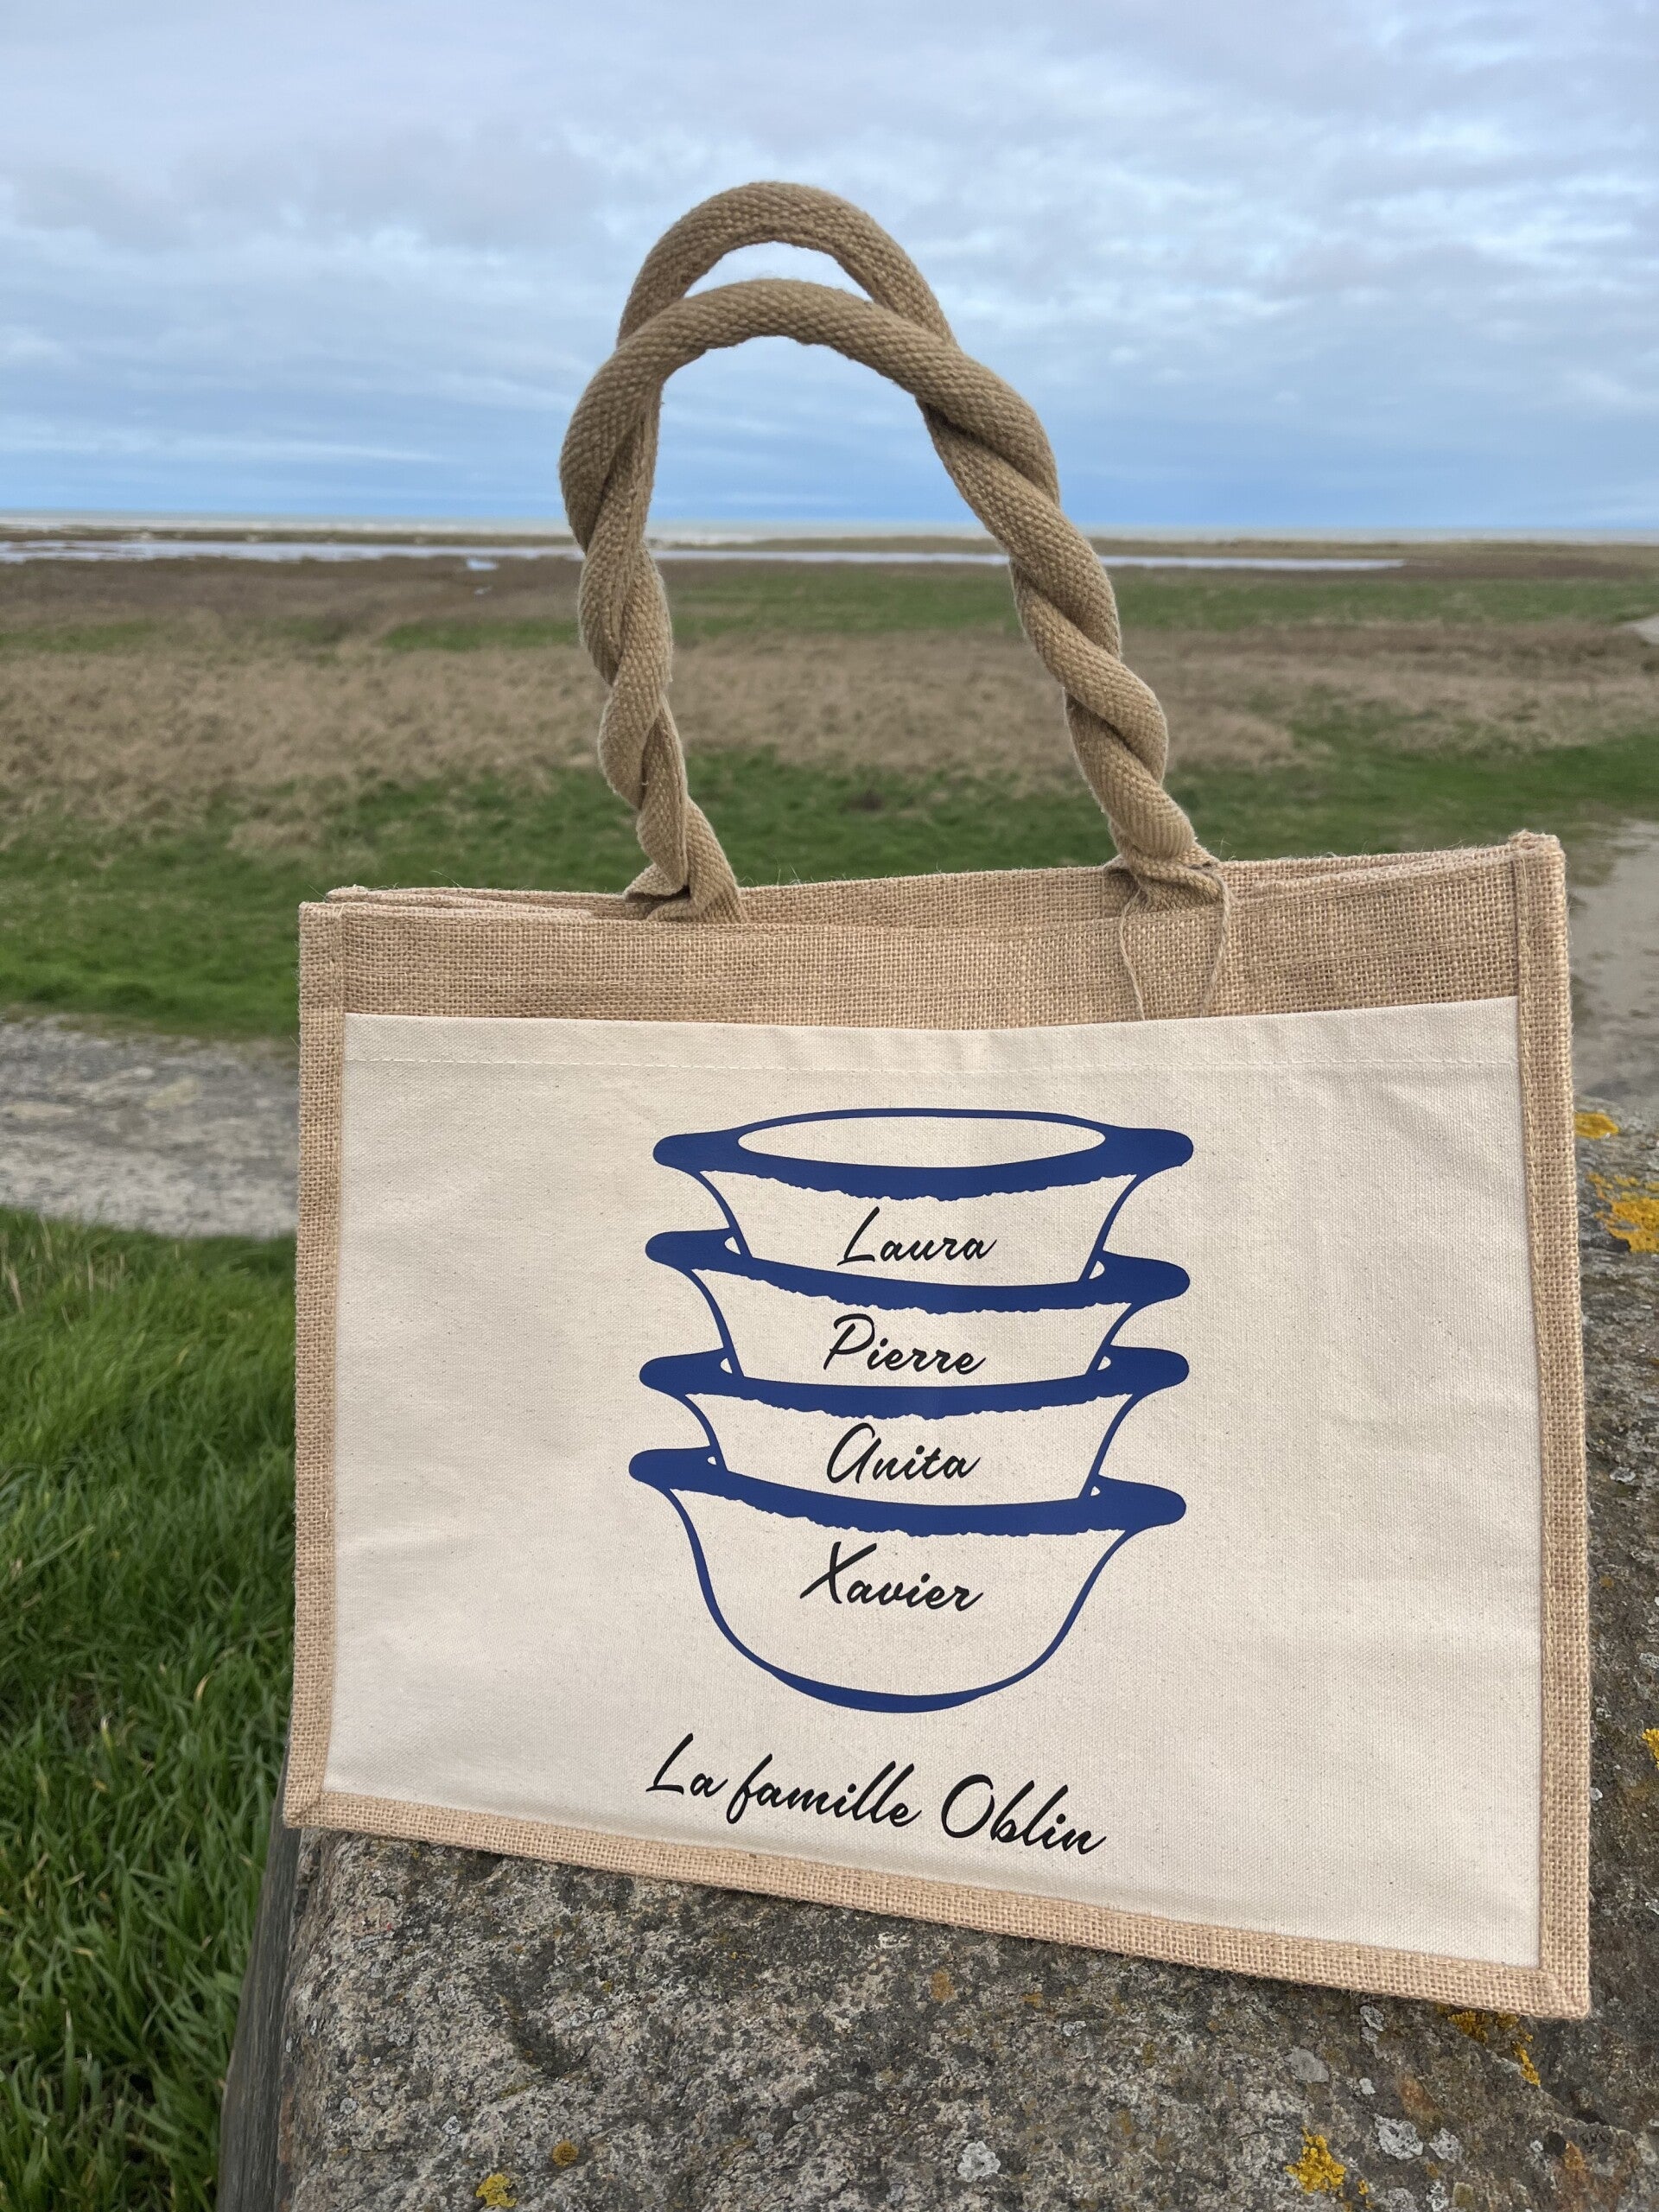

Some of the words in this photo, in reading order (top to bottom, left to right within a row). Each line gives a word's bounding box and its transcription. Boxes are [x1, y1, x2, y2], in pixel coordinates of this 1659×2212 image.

[836, 1205, 997, 1267] Laura
[823, 1313, 987, 1376] Pierre
[826, 1422, 982, 1484] Anita
[799, 1541, 984, 1611] Xavier
[645, 1732, 728, 1798] La
[726, 1753, 922, 1827] famille
[941, 1774, 1107, 1855] Oblin
